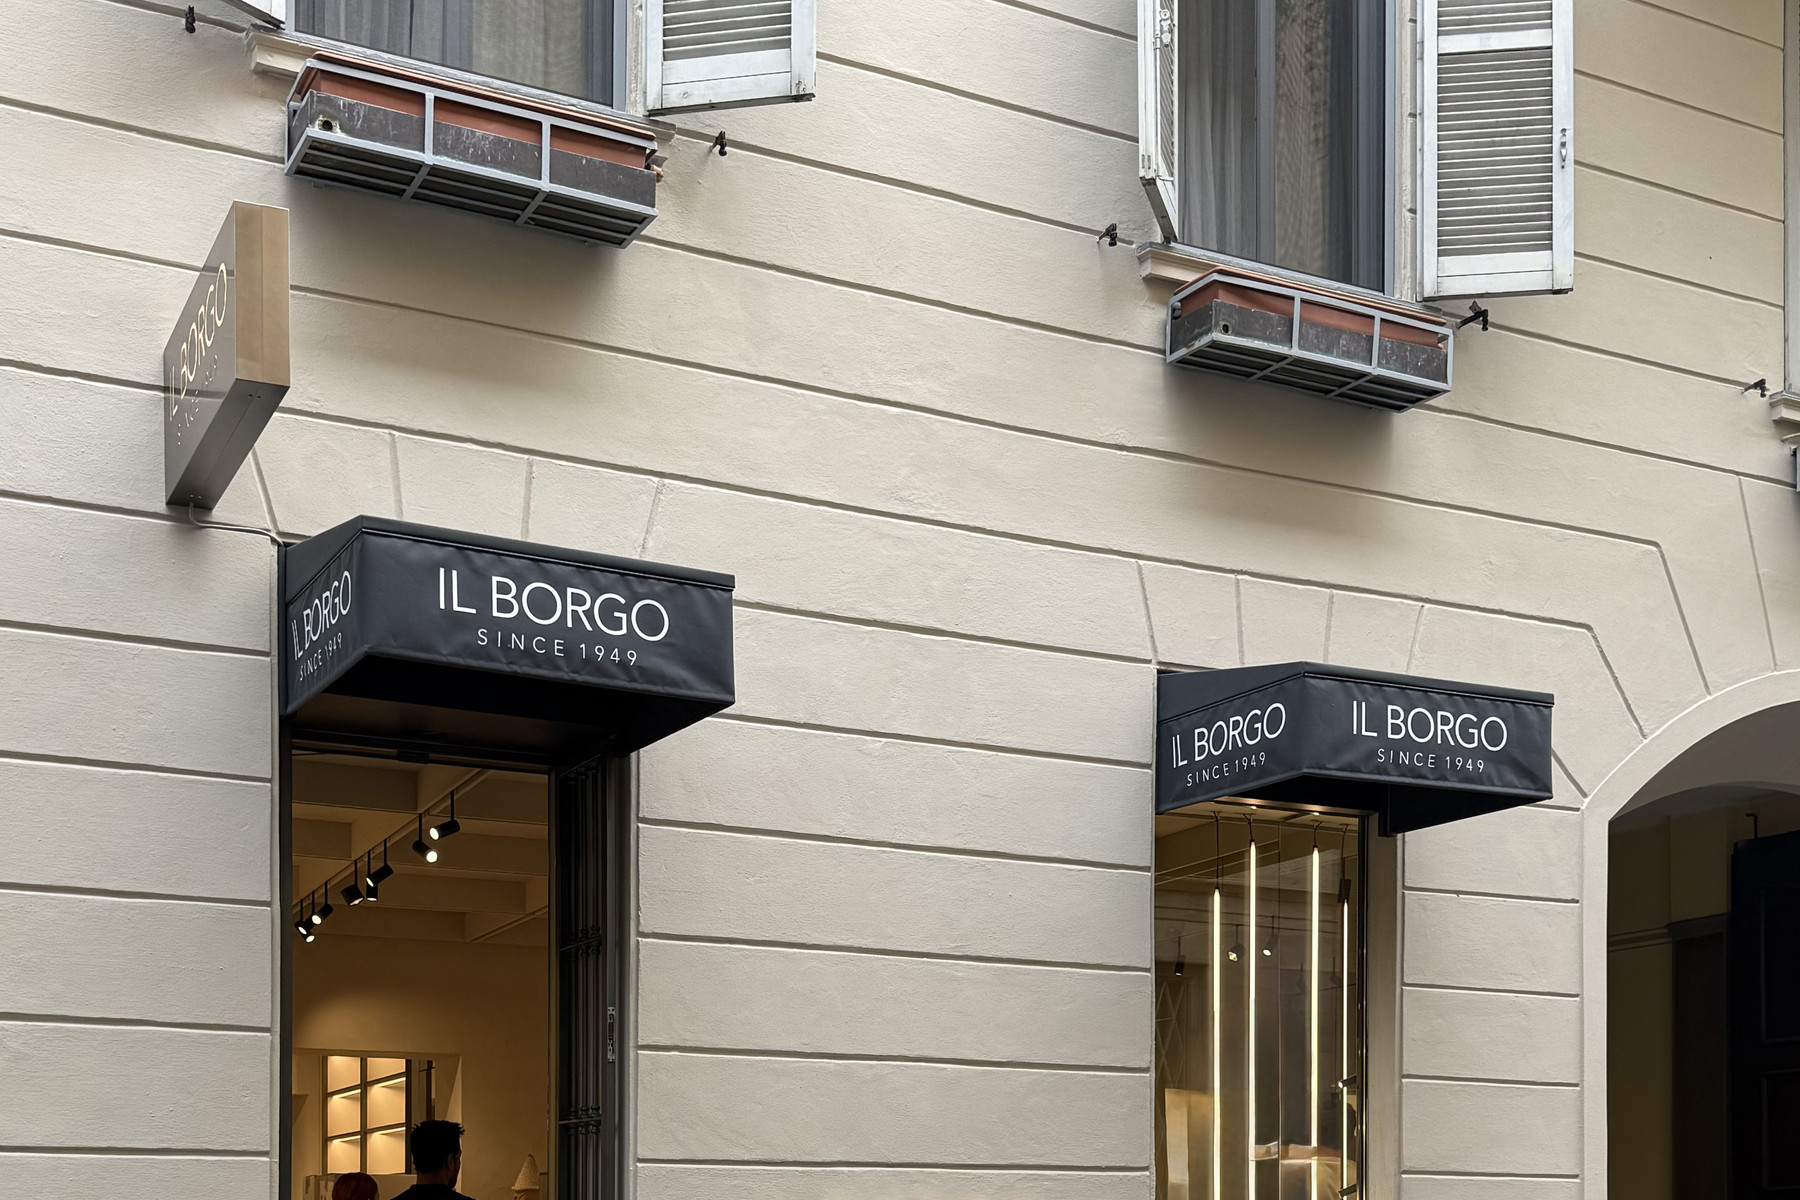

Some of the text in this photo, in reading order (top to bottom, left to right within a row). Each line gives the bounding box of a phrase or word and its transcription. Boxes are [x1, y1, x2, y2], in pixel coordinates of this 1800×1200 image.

[169, 365, 178, 421] IL
[180, 262, 227, 400] BORGO
[291, 570, 351, 661] IL BORGO
[439, 567, 669, 641] IL BORGO
[300, 632, 342, 681] SINCE 1949
[477, 629, 637, 666] SINCE 1949
[1172, 702, 1286, 769] IL BORGO
[1353, 700, 1508, 752] IL BORGO
[1186, 751, 1266, 787] SINCE 1949
[1377, 748, 1484, 773] SINCE 1949
